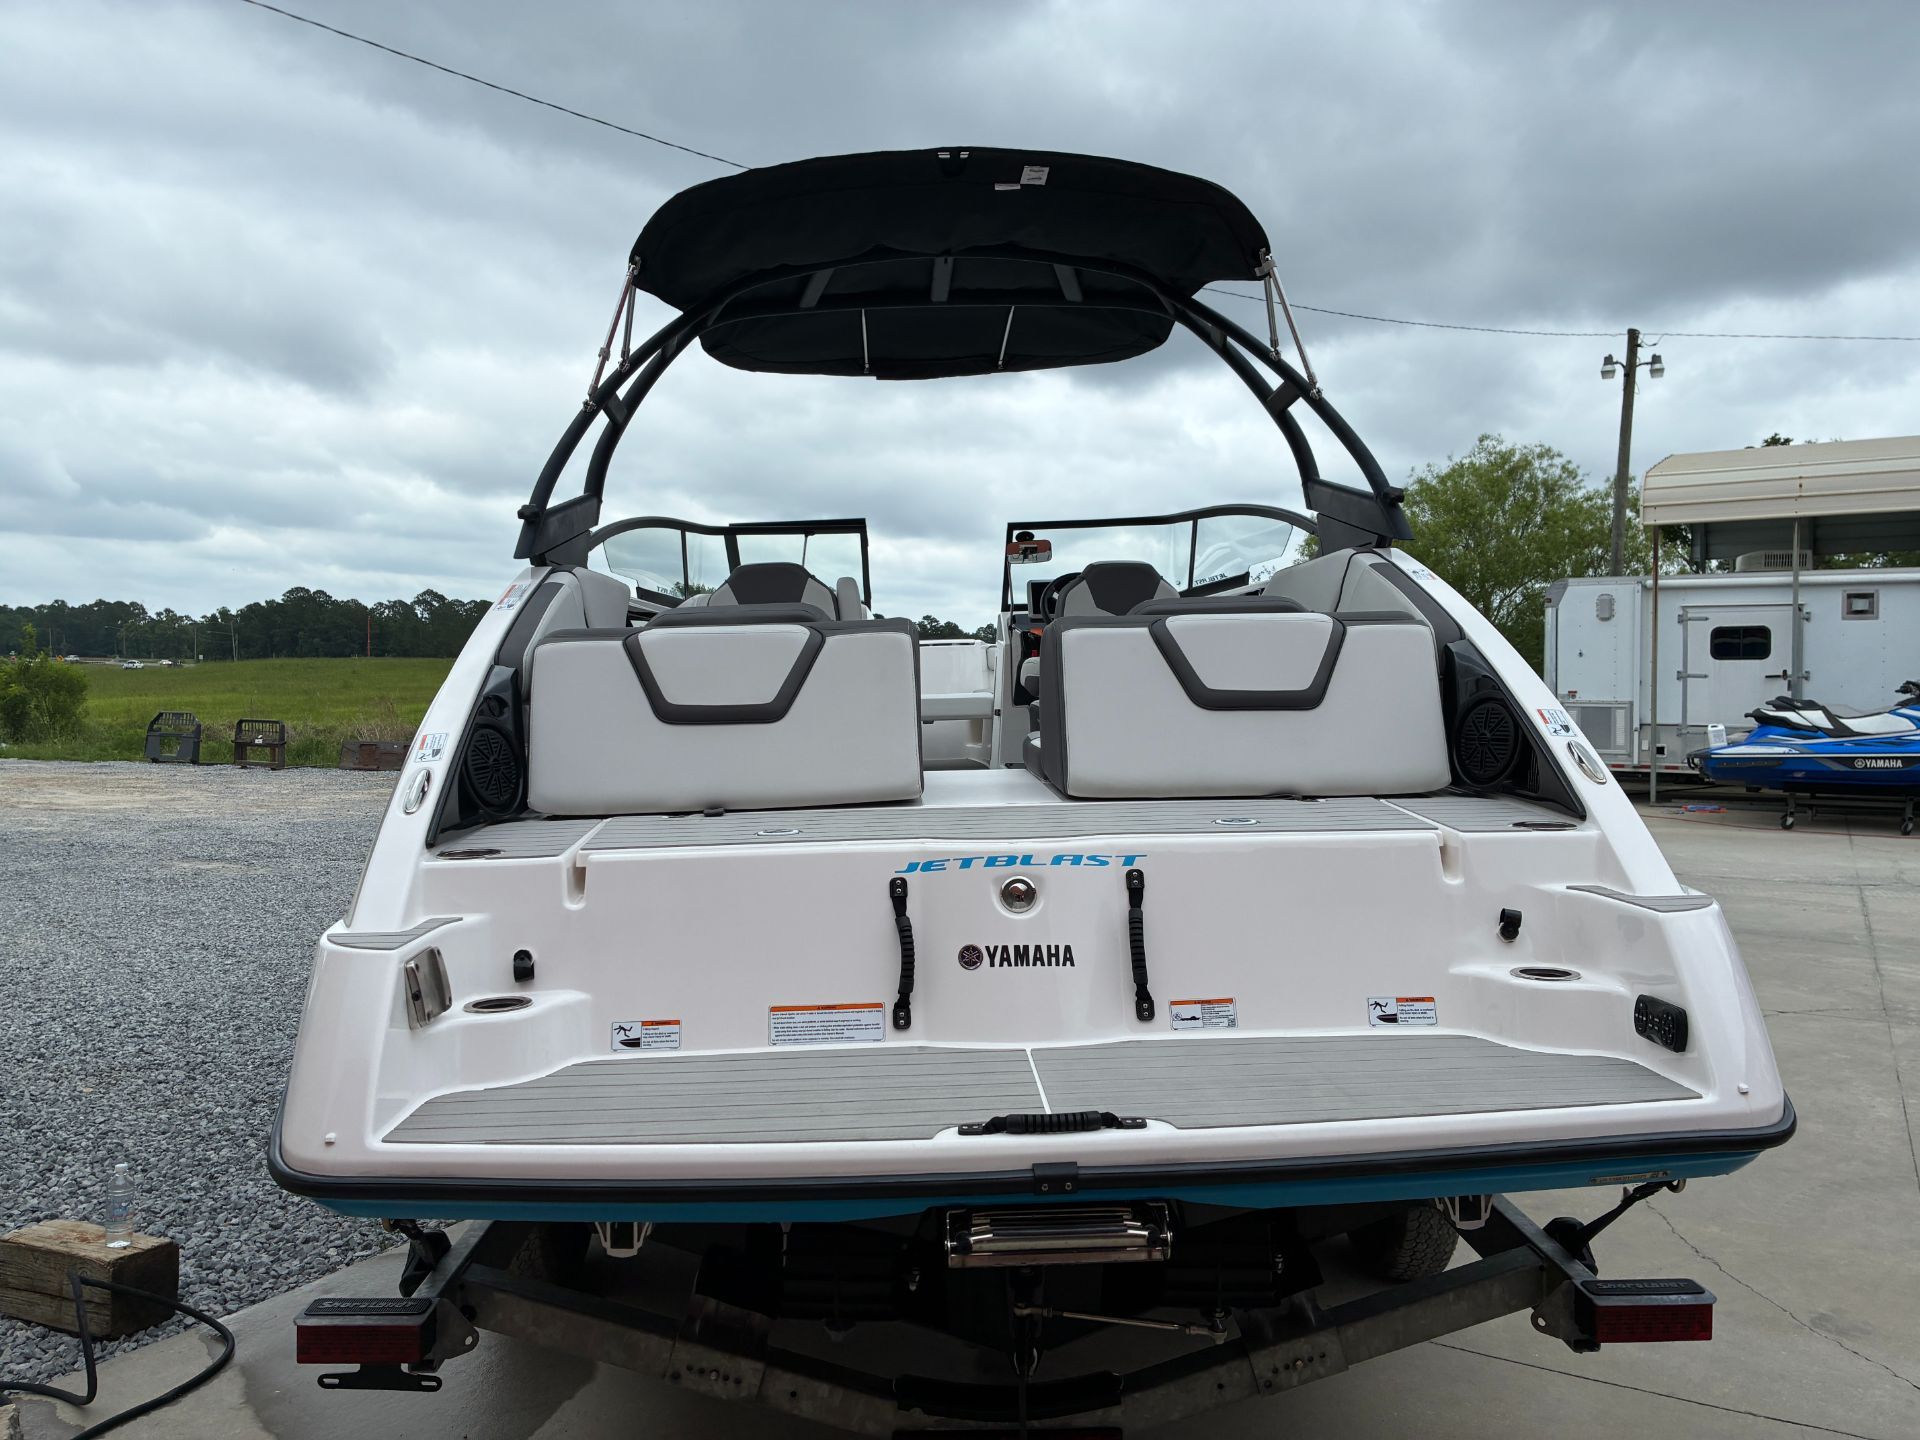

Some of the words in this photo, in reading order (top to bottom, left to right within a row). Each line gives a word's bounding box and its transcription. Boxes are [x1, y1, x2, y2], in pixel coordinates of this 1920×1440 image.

[1865, 758, 1903, 768] YAMAHA
[894, 854, 1148, 874] JETBLAST
[985, 944, 1076, 968] YAMAHA
